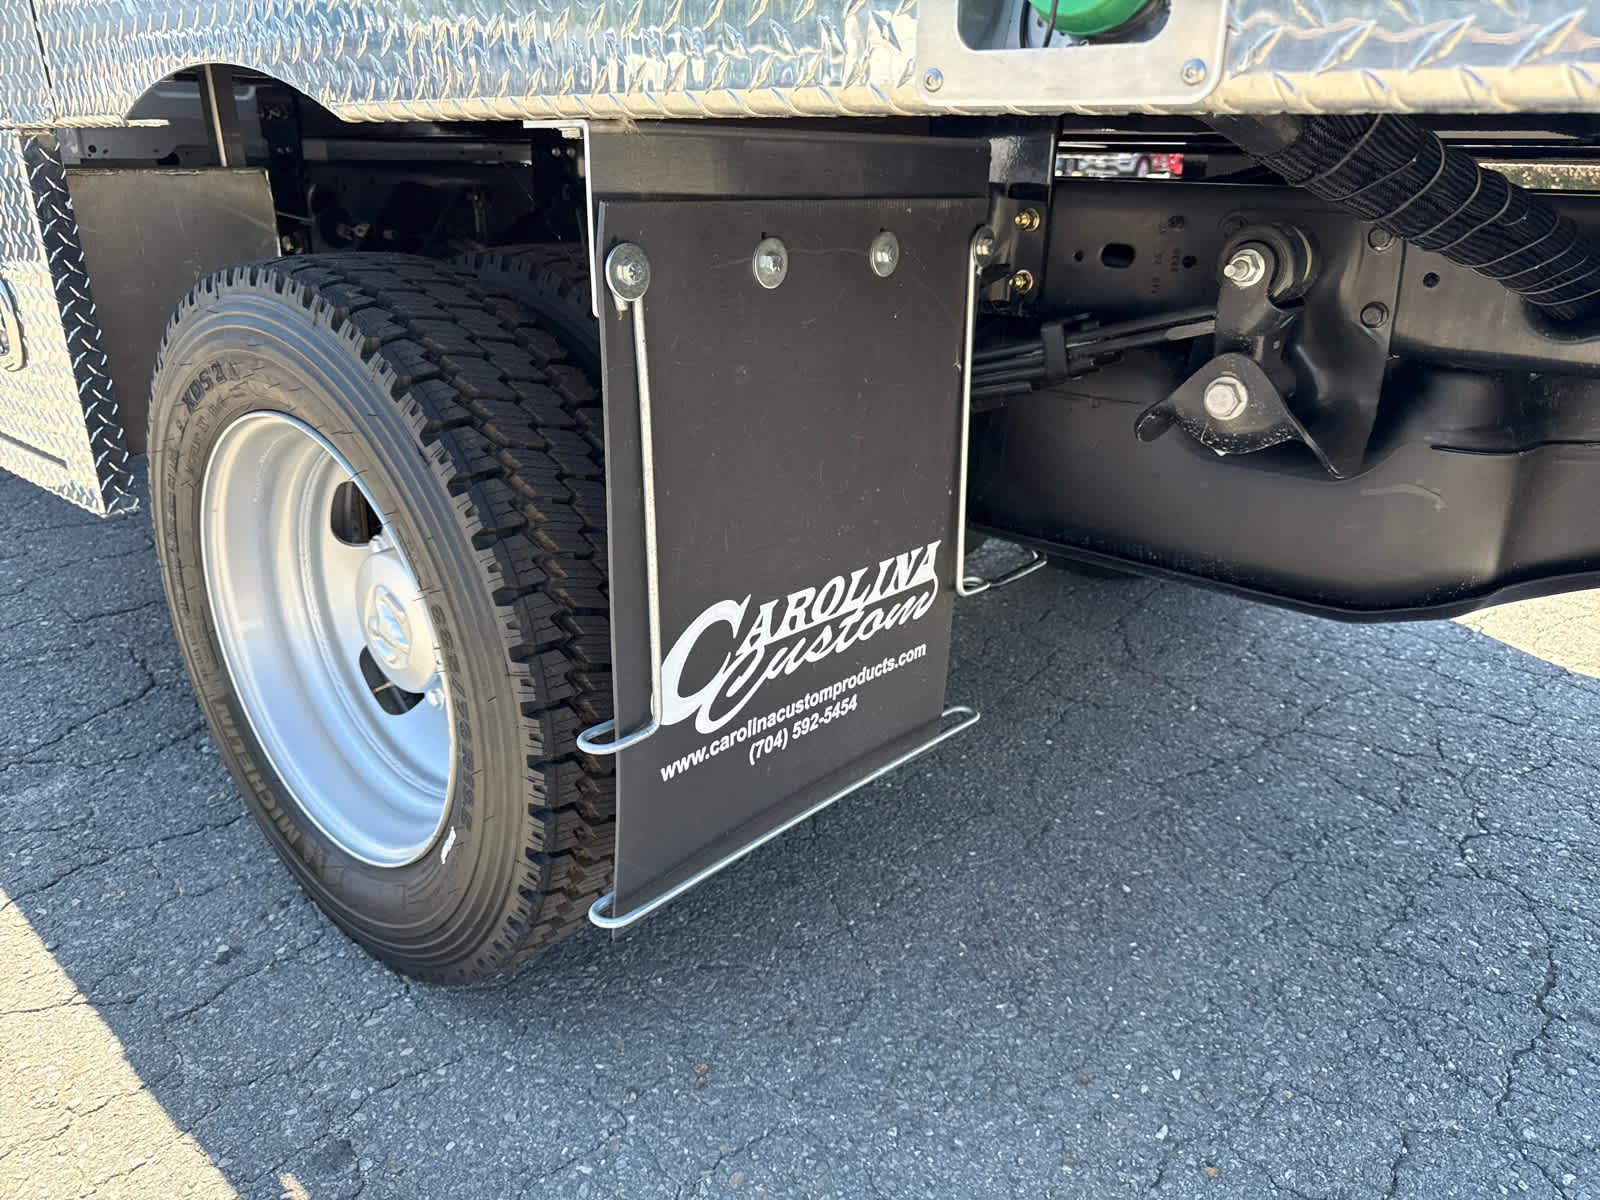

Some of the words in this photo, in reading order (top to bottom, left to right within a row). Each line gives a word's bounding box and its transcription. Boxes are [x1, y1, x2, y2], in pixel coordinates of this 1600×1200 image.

[651, 540, 942, 726] CAROLINA
[694, 580, 939, 735] Custom
[659, 643, 927, 782] www.carolinacustomproducts.com
[748, 727, 789, 766] (704)
[791, 694, 858, 741] 592-5454
